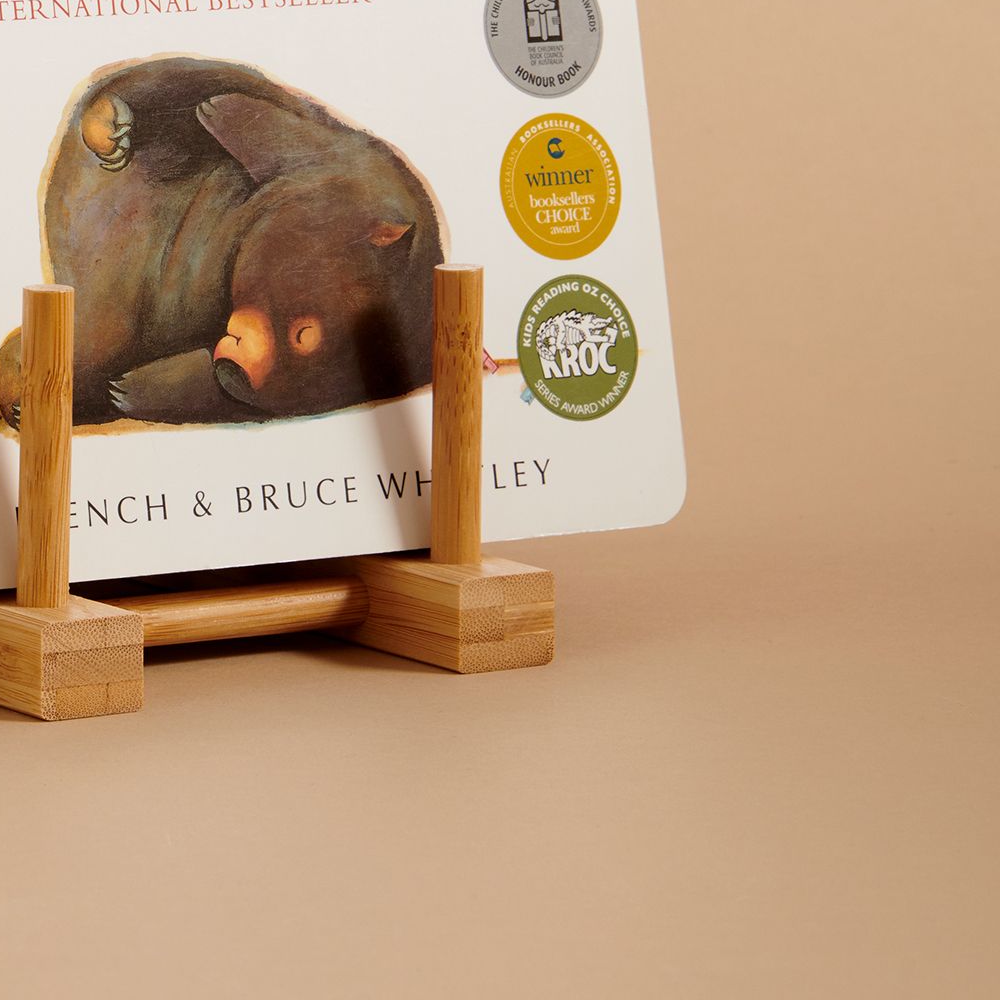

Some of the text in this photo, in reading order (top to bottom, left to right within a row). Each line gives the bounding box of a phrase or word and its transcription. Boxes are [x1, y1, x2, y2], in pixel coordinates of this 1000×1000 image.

[491, 21, 499, 38] THE
[514, 61, 582, 87] HONOUR BOOK
[504, 119, 616, 209] AUSTRALIAN BOOKSELLERS ASSOCIATION
[525, 165, 594, 189] winner
[529, 191, 596, 208] booksellers
[535, 207, 593, 224] CHOICE
[550, 222, 581, 235] award
[522, 281, 631, 347] KIDS READING OZ CHOICE
[540, 341, 617, 379] KROC
[534, 370, 630, 416] SERIES AWARD WINNER
[15, 493, 168, 530] ENCH
[192, 490, 213, 518] &
[235, 476, 358, 513] BRUCE
[377, 458, 551, 500] WHLEY
